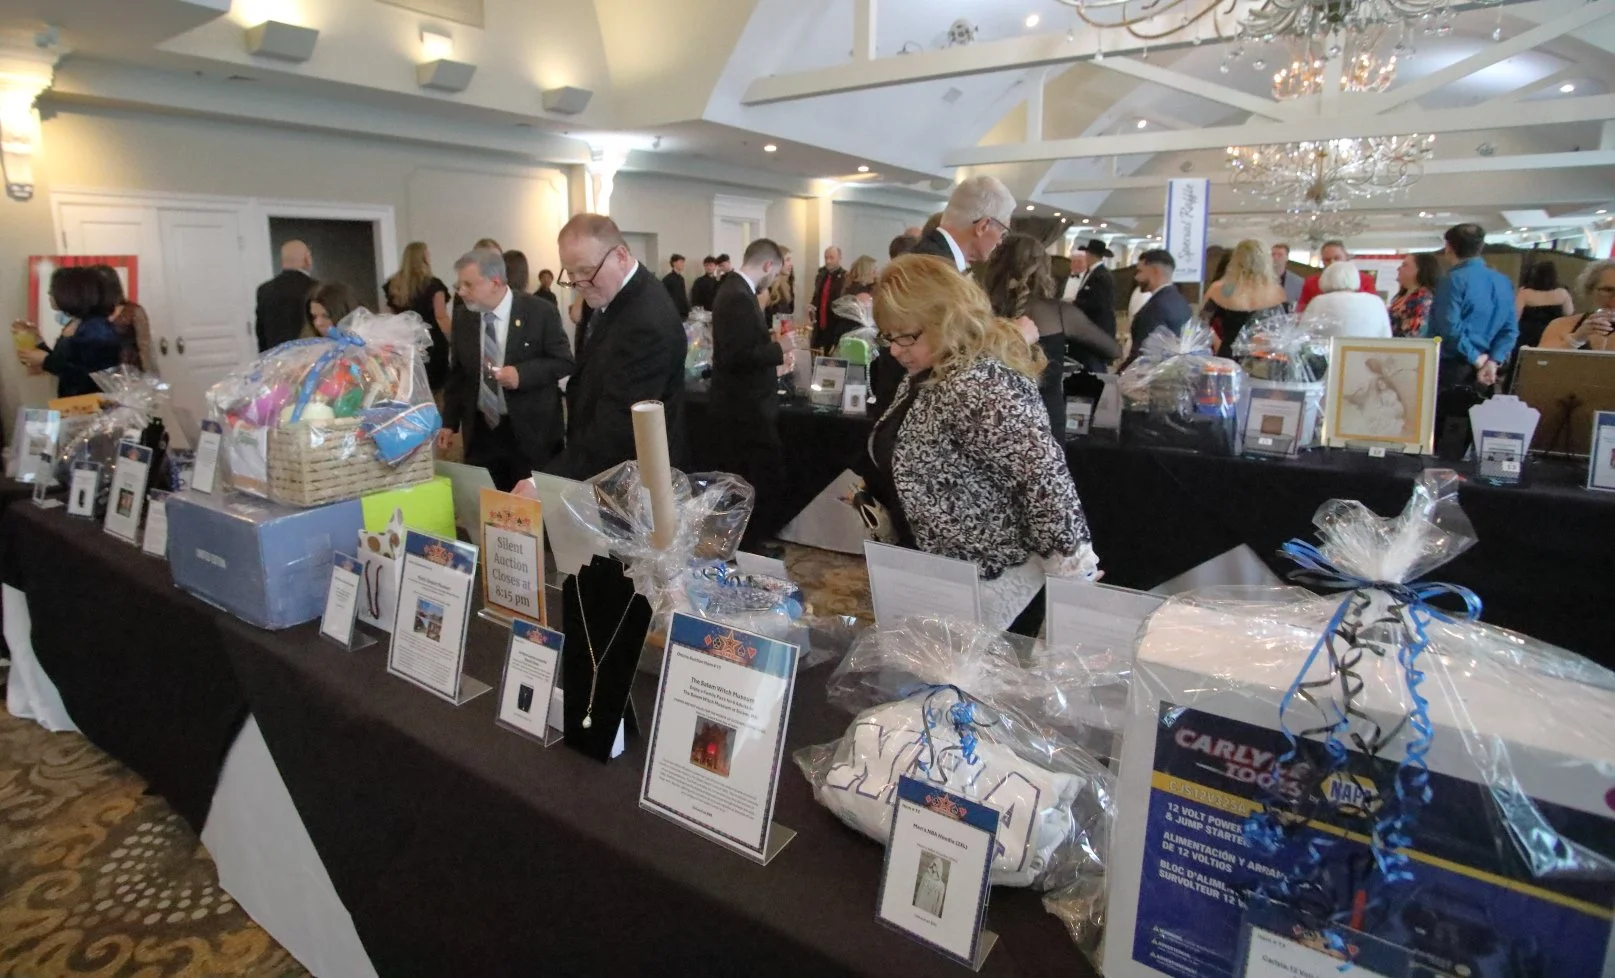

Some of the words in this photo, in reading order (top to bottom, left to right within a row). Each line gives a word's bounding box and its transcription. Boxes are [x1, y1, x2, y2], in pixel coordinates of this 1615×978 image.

[1180, 183, 1198, 218] Raffle
[497, 536, 523, 554] Silent
[494, 552, 529, 573] Auction
[492, 568, 520, 586] Closes
[522, 580, 531, 590] at
[495, 585, 513, 602] 8:15
[515, 594, 530, 607] pm
[691, 676, 701, 684] The
[700, 680, 717, 690] Salem
[717, 685, 732, 696] Witch
[732, 691, 755, 703] Museum
[702, 696, 715, 704] Witch
[714, 700, 732, 710] Museum
[1174, 728, 1311, 780] CARLYE
[1225, 761, 1303, 798] TOOS
[1165, 812, 1173, 821] &
[1175, 816, 1204, 831] JUMP
[1167, 802, 1179, 813] 12
[1181, 806, 1206, 822] VOLT
[912, 823, 927, 833] Men's
[927, 828, 938, 837] NBA
[1162, 840, 1176, 852] DE
[1178, 846, 1189, 858] 12
[1192, 851, 1233, 873] VOLTIOS
[1163, 831, 1236, 864] ALIMENTACIÓN
[1238, 857, 1246, 867] Y
[1160, 859, 1185, 875] BLOC
[1159, 869, 1220, 900] SURVOLTEUR
[1223, 893, 1236, 905] 12
